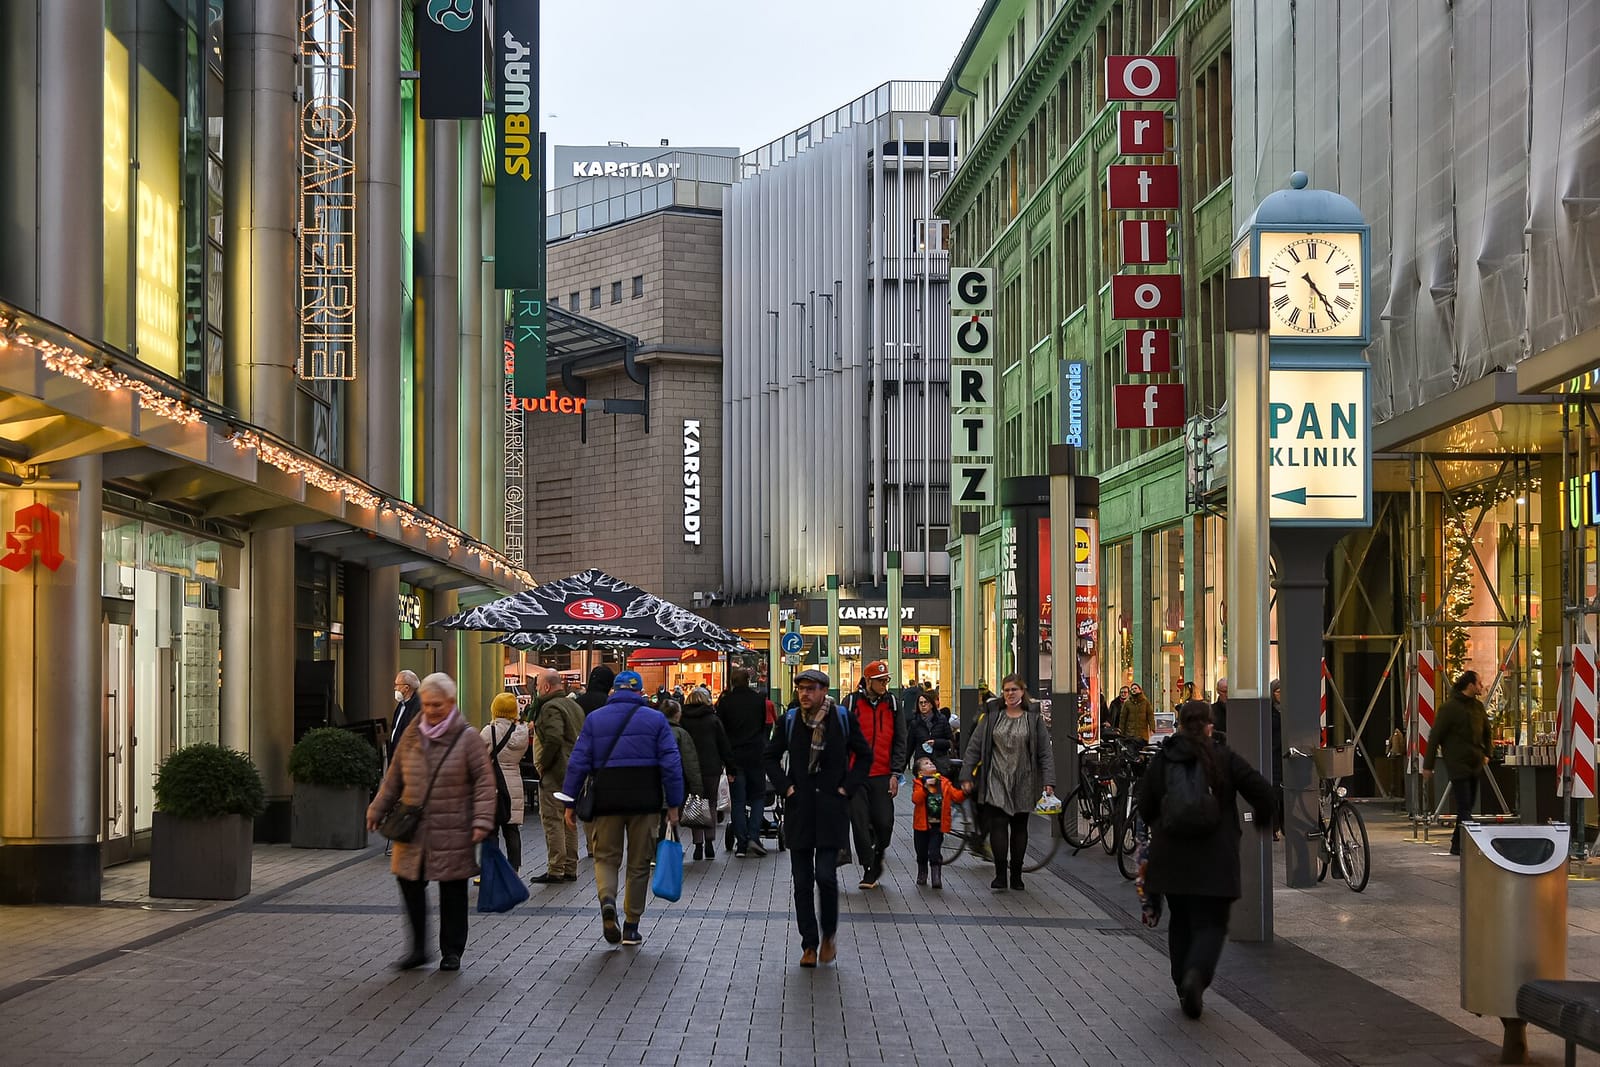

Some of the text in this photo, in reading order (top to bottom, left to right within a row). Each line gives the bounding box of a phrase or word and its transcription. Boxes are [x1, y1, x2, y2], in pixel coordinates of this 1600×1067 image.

[503, 30, 531, 182] SUBWAY
[572, 161, 681, 178] KARSTADT
[300, 95, 358, 380] GALERIE
[1122, 57, 1162, 427] Ortloff
[519, 288, 541, 343] RK
[1065, 363, 1082, 448] Barmenia
[1269, 402, 1357, 439] PAN
[1269, 447, 1357, 467] KLINIK
[683, 419, 701, 546] KARSTADT
[546, 623, 639, 635] mocambo
[838, 606, 915, 620] KARSTDT
[838, 645, 862, 656] ARST
